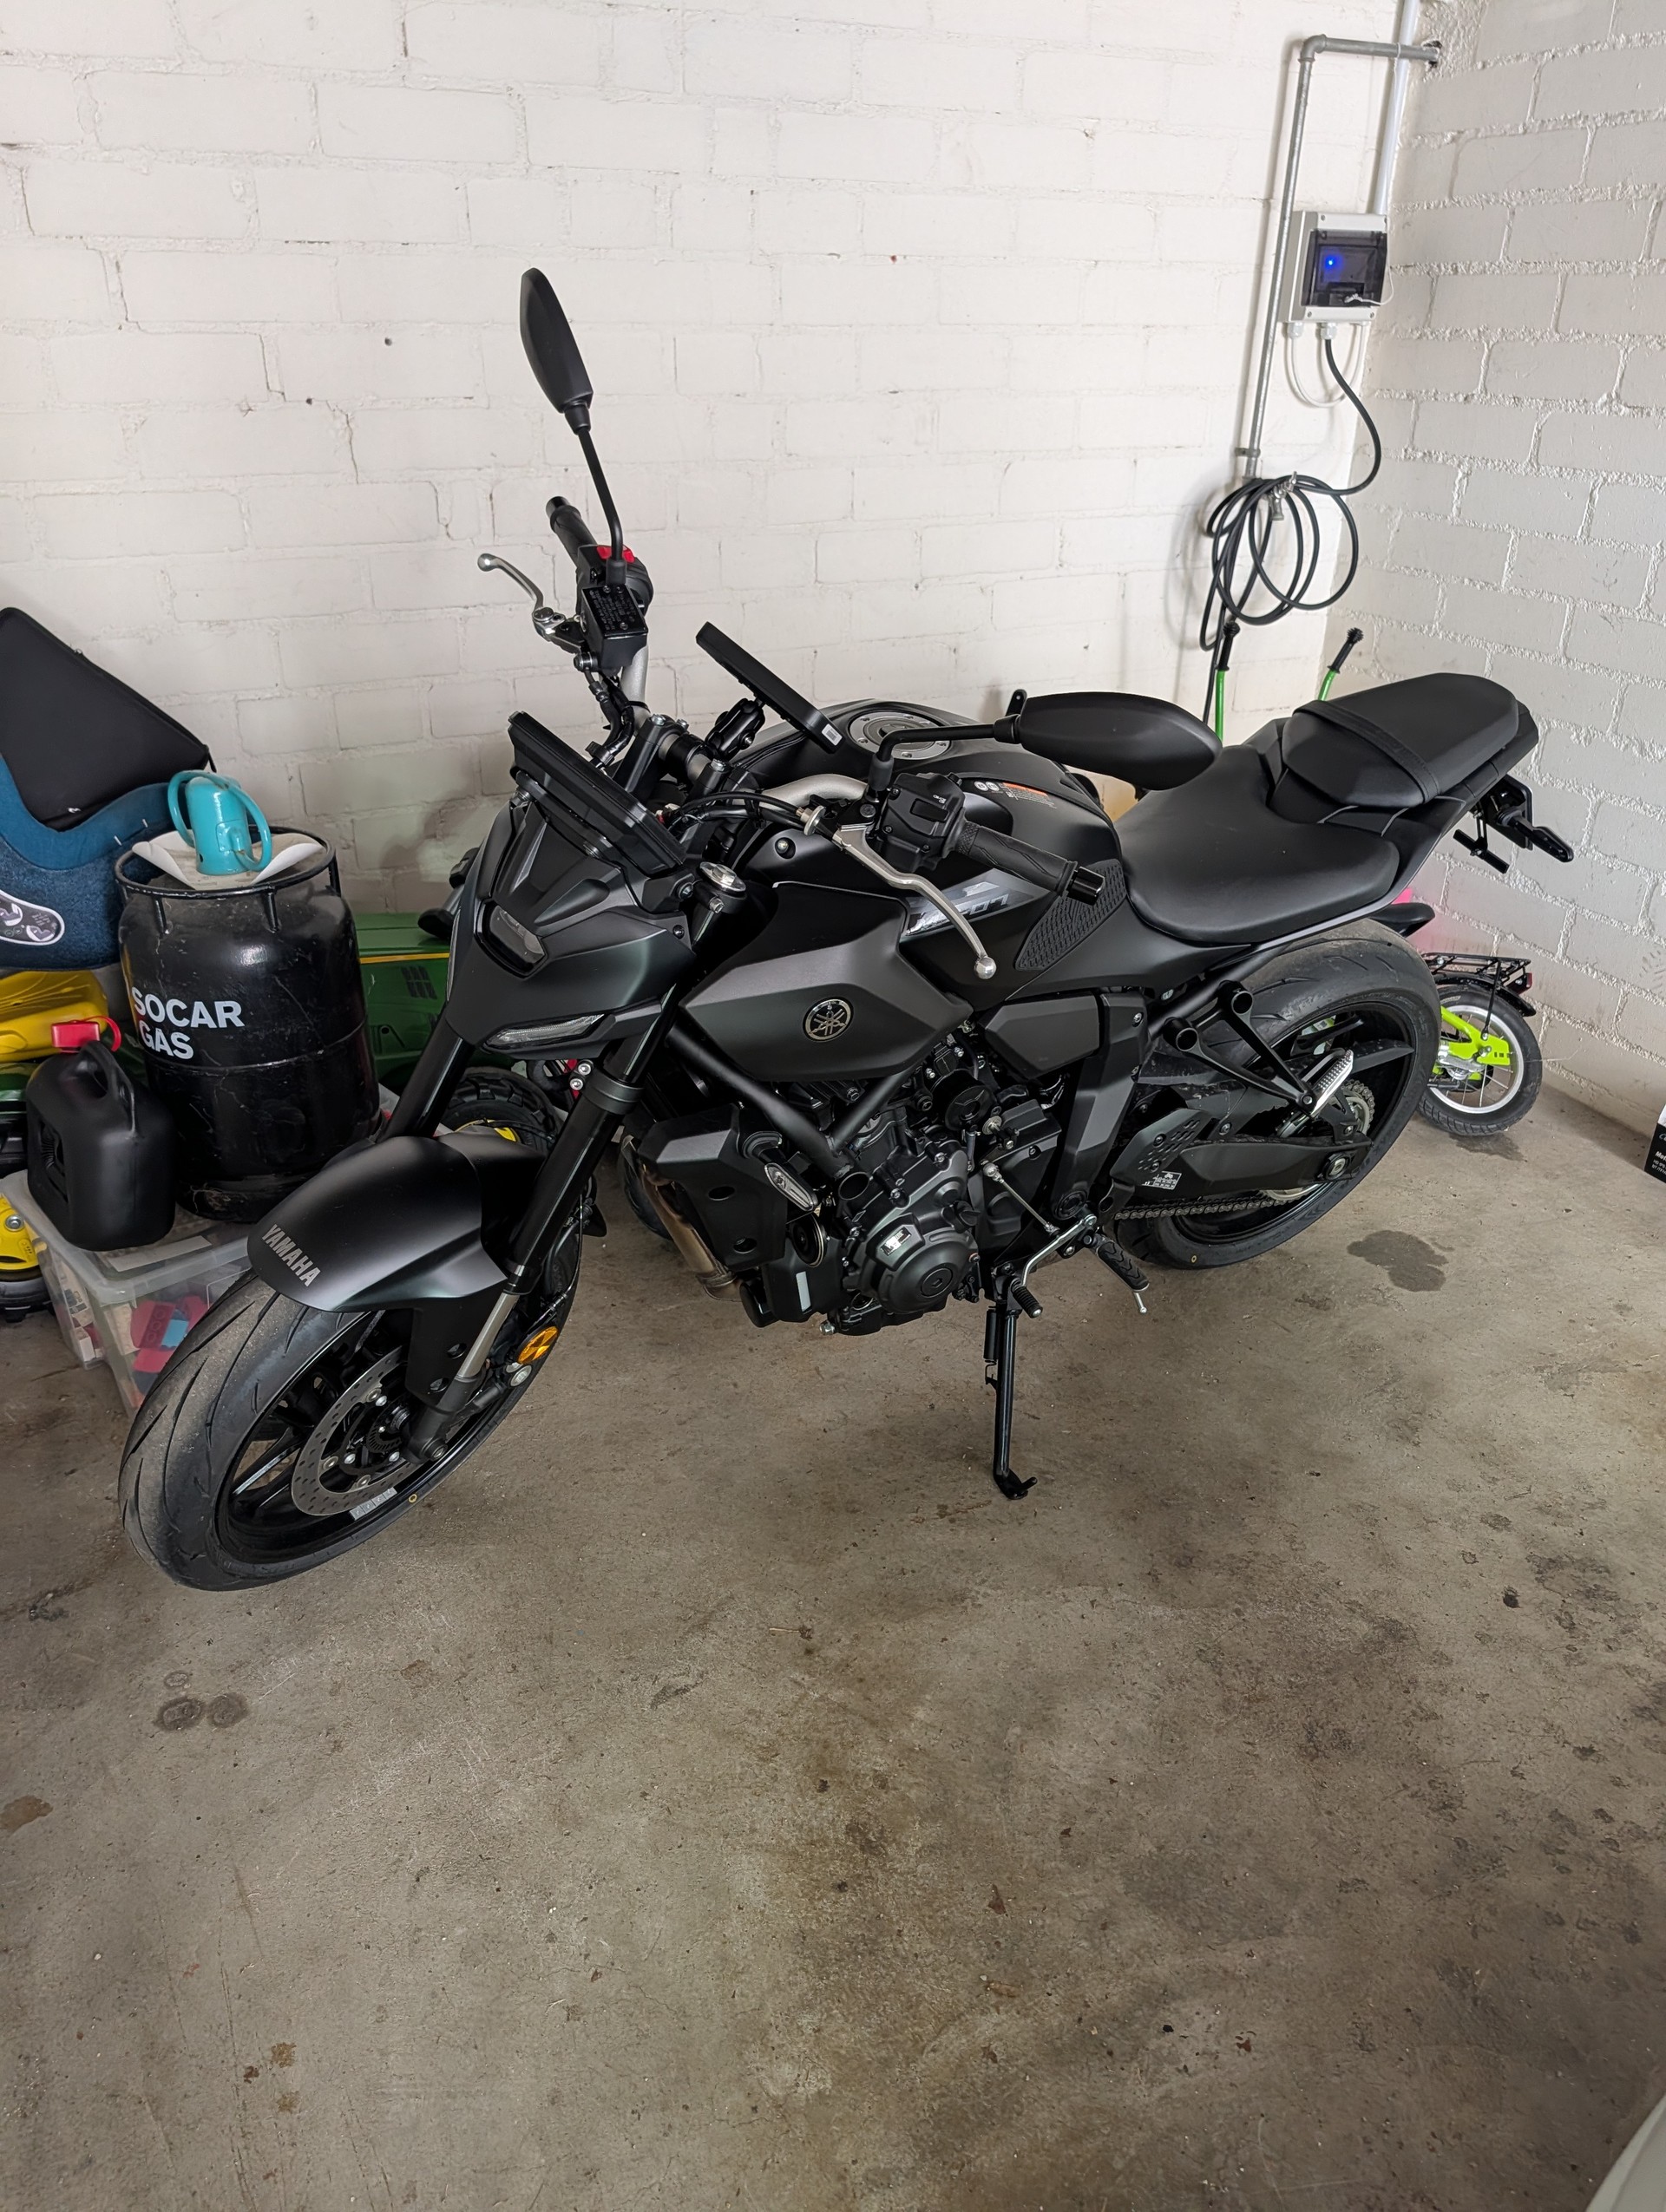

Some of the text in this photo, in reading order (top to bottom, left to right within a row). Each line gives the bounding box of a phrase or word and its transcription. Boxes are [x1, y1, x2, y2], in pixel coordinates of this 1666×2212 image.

[132, 987, 245, 1028] SOCAR
[139, 1019, 194, 1059] GAS
[262, 1224, 321, 1286] YAMAHA
